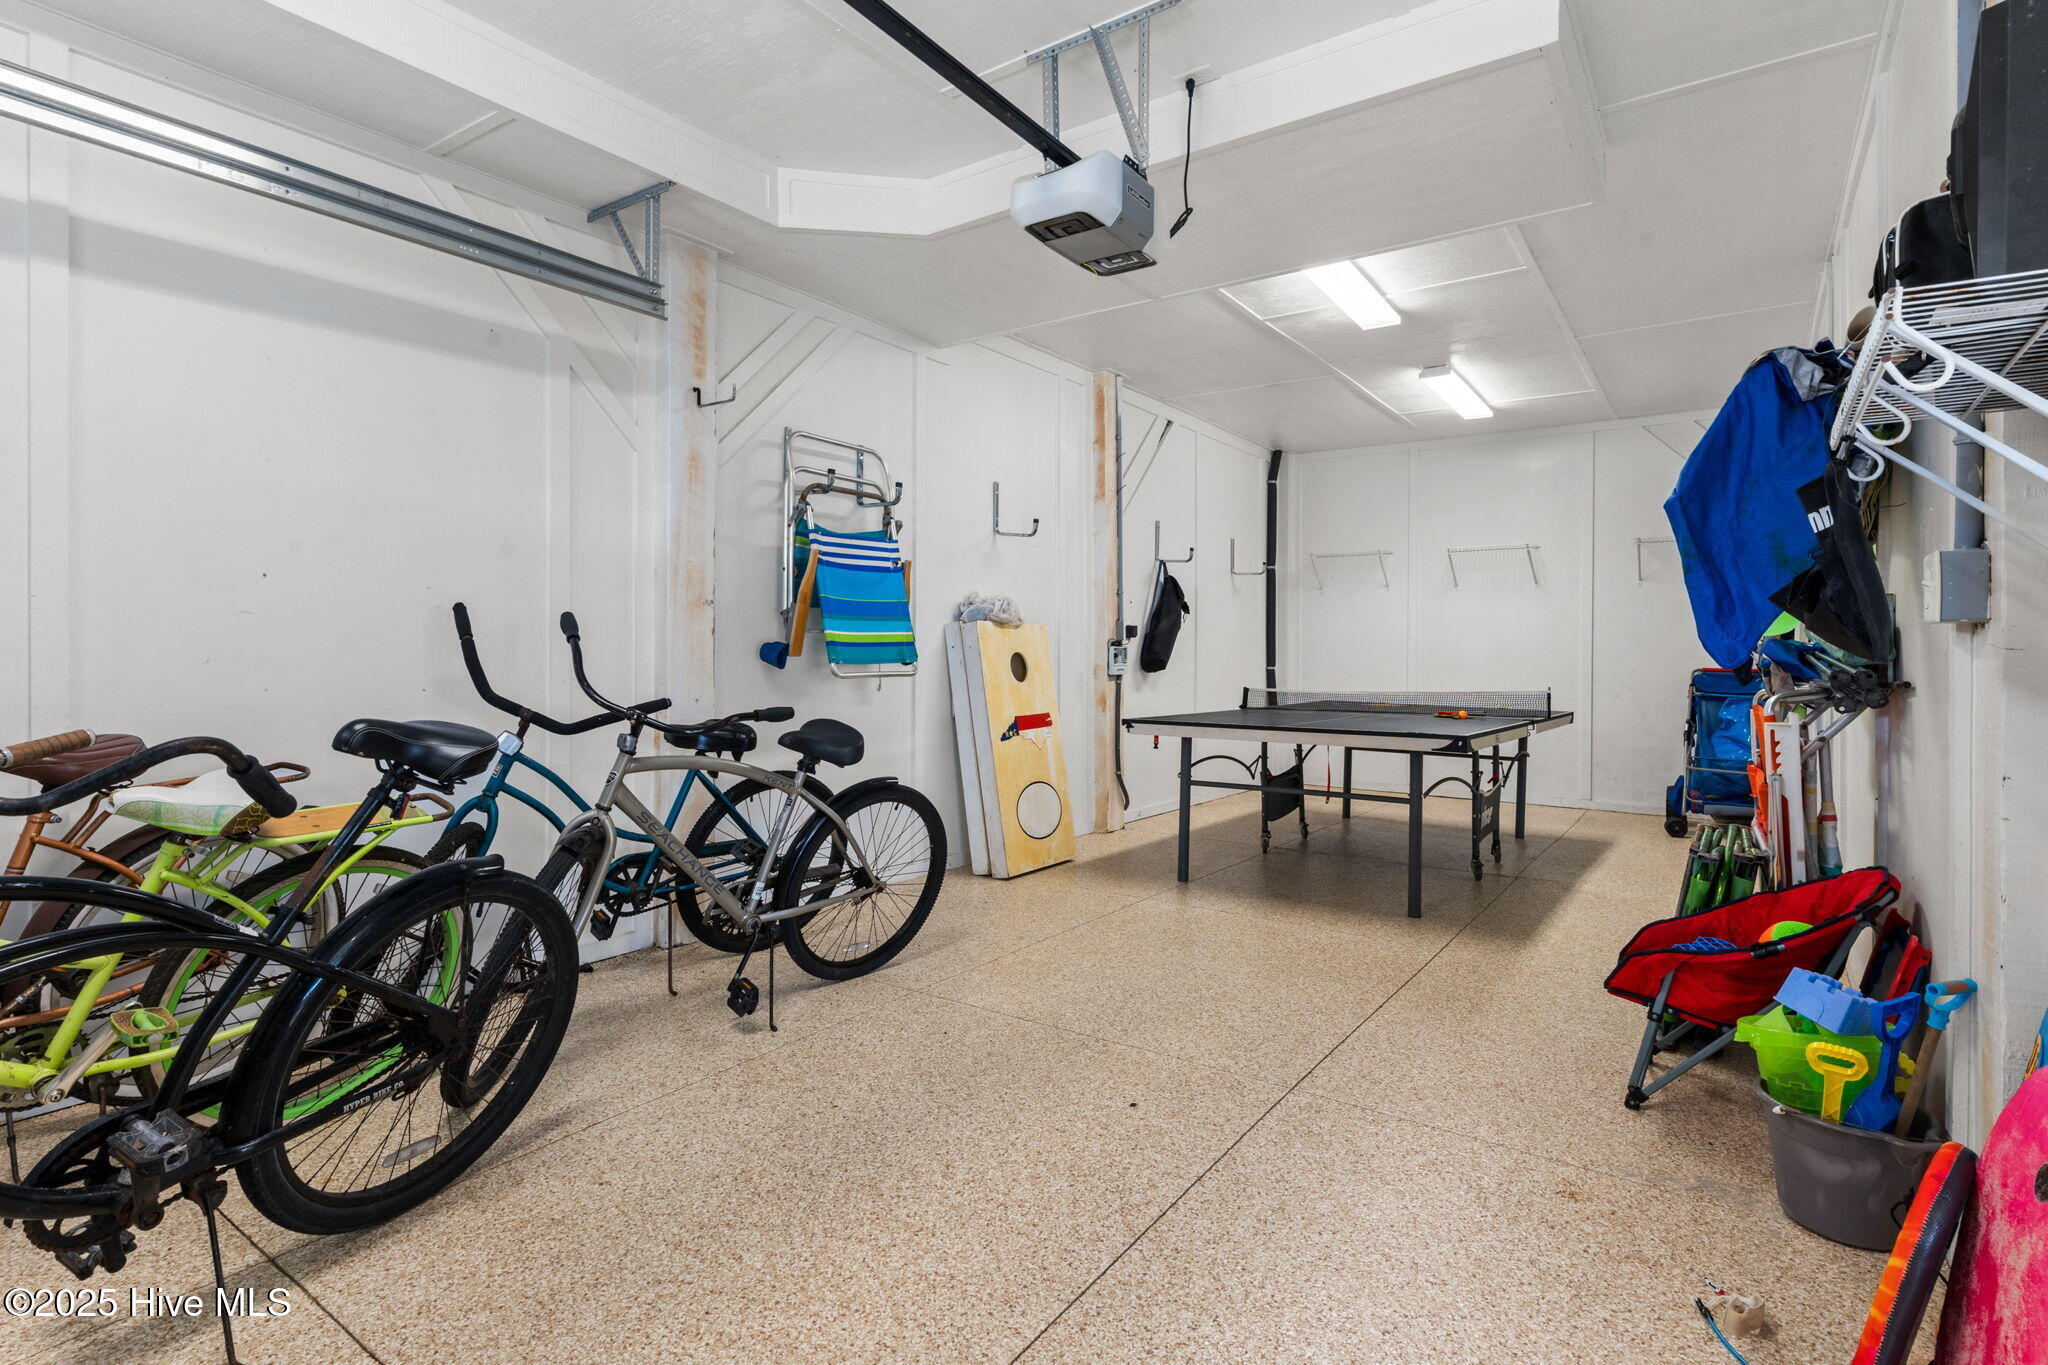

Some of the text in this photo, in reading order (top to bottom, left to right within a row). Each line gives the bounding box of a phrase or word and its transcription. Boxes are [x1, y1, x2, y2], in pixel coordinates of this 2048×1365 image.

[636, 811, 725, 896] SEACHANGE
[343, 1095, 371, 1113] HYPER
[372, 1085, 393, 1100] BIKE
